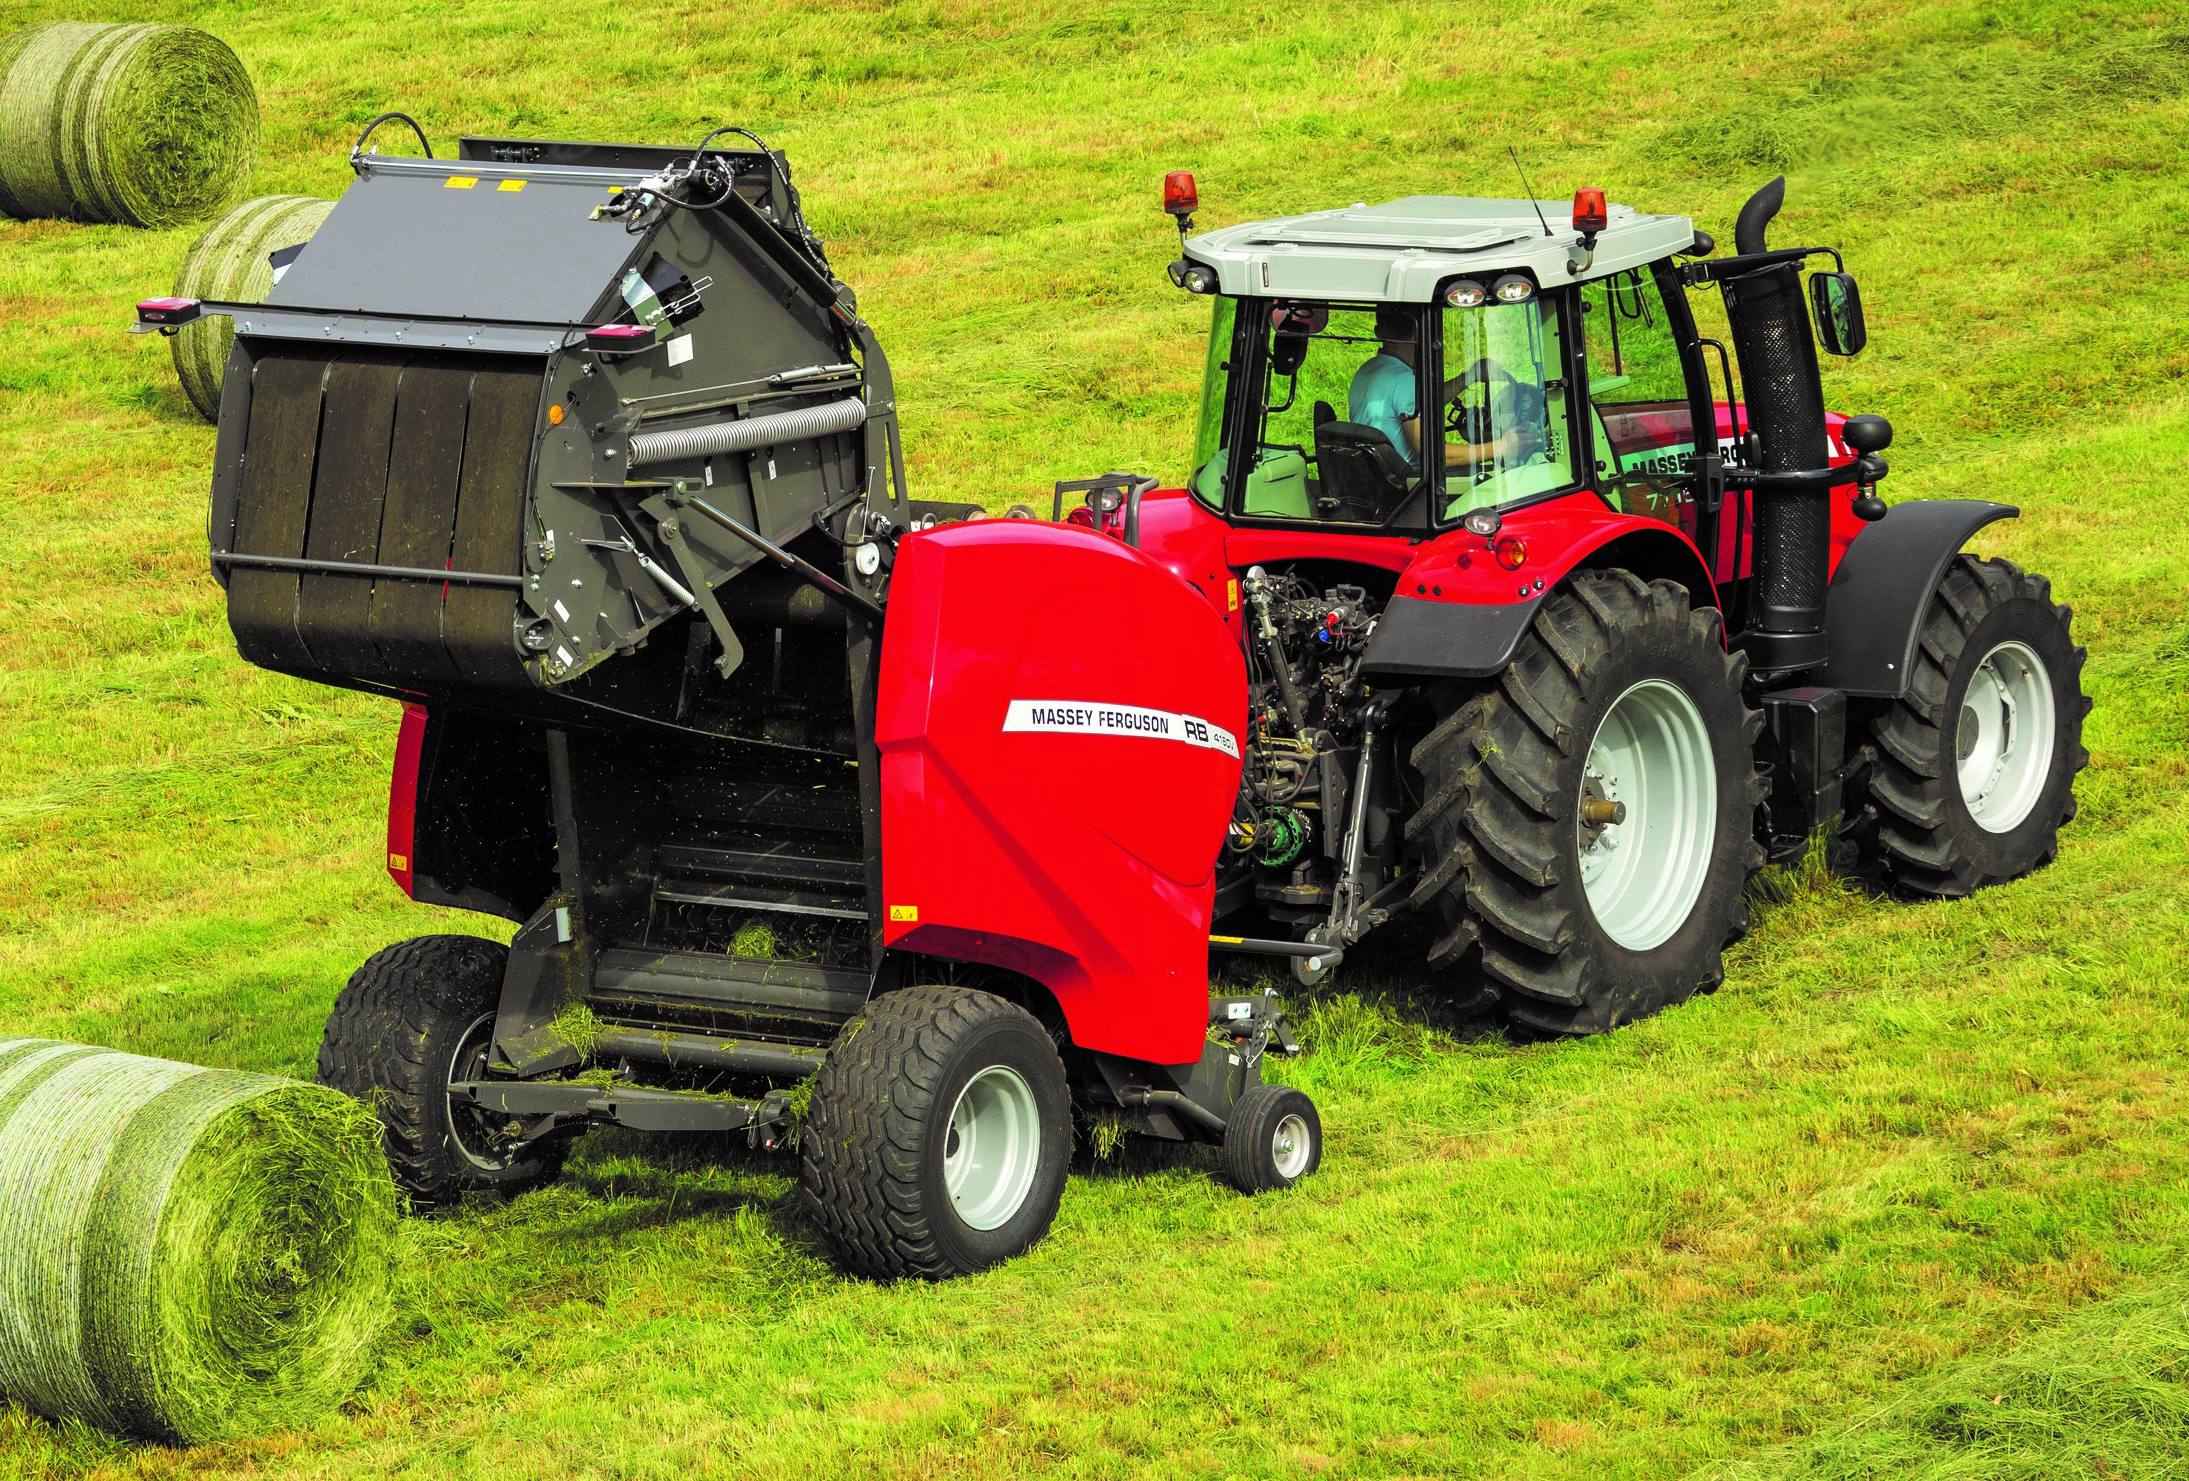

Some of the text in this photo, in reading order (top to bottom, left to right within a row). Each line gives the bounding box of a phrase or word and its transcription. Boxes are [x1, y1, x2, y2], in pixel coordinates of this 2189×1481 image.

[1032, 708, 1093, 726] MASSEY
[1098, 710, 1169, 734] FERGUSON
[1184, 719, 1209, 743] RB
